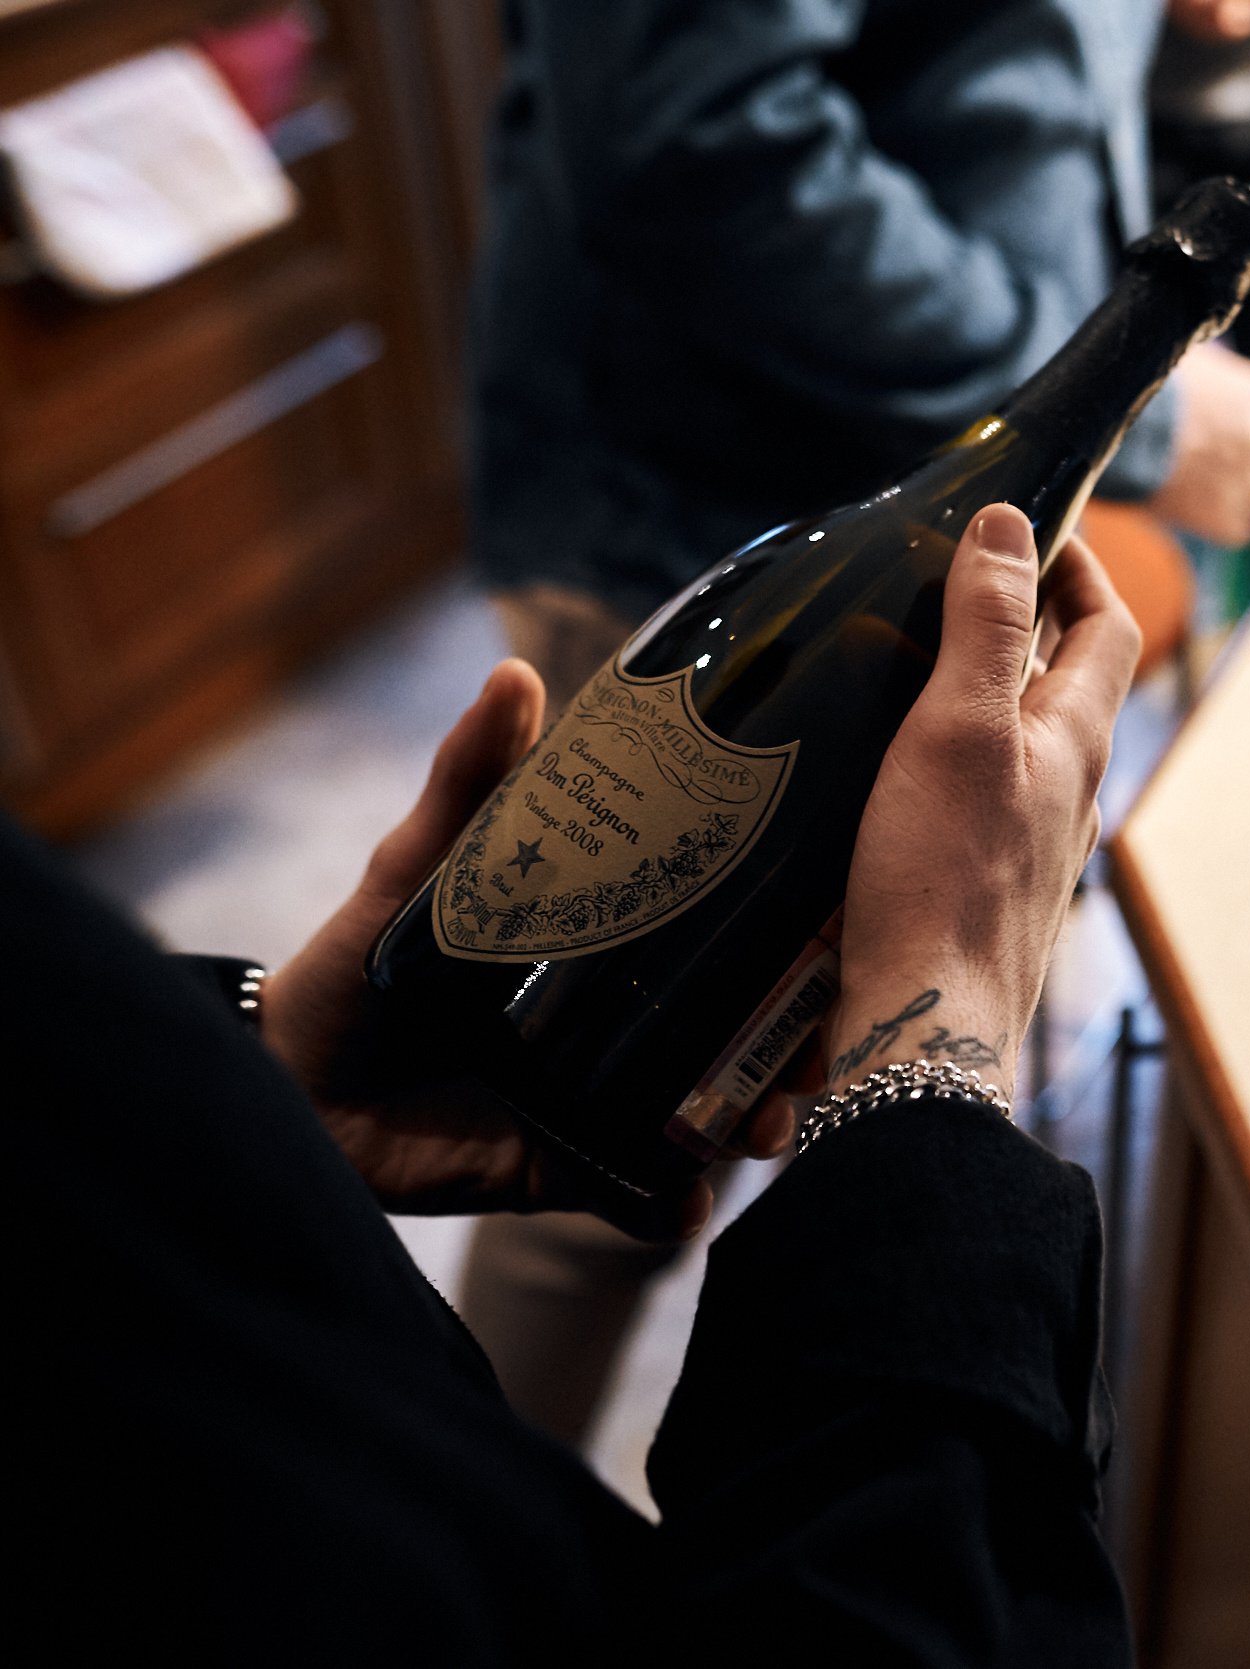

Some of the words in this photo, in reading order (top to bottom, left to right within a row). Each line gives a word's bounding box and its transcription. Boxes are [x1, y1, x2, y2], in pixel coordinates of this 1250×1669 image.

[536, 751, 567, 790] Dom
[567, 773, 640, 845] Pérignon
[569, 737, 645, 801] Champagne
[524, 791, 561, 829] Vintage
[560, 819, 604, 857] 2008
[489, 872, 514, 897] Brut
[569, 931, 602, 945] PRODUCT
[604, 927, 612, 937] OF
[613, 919, 640, 933] FRANCE
